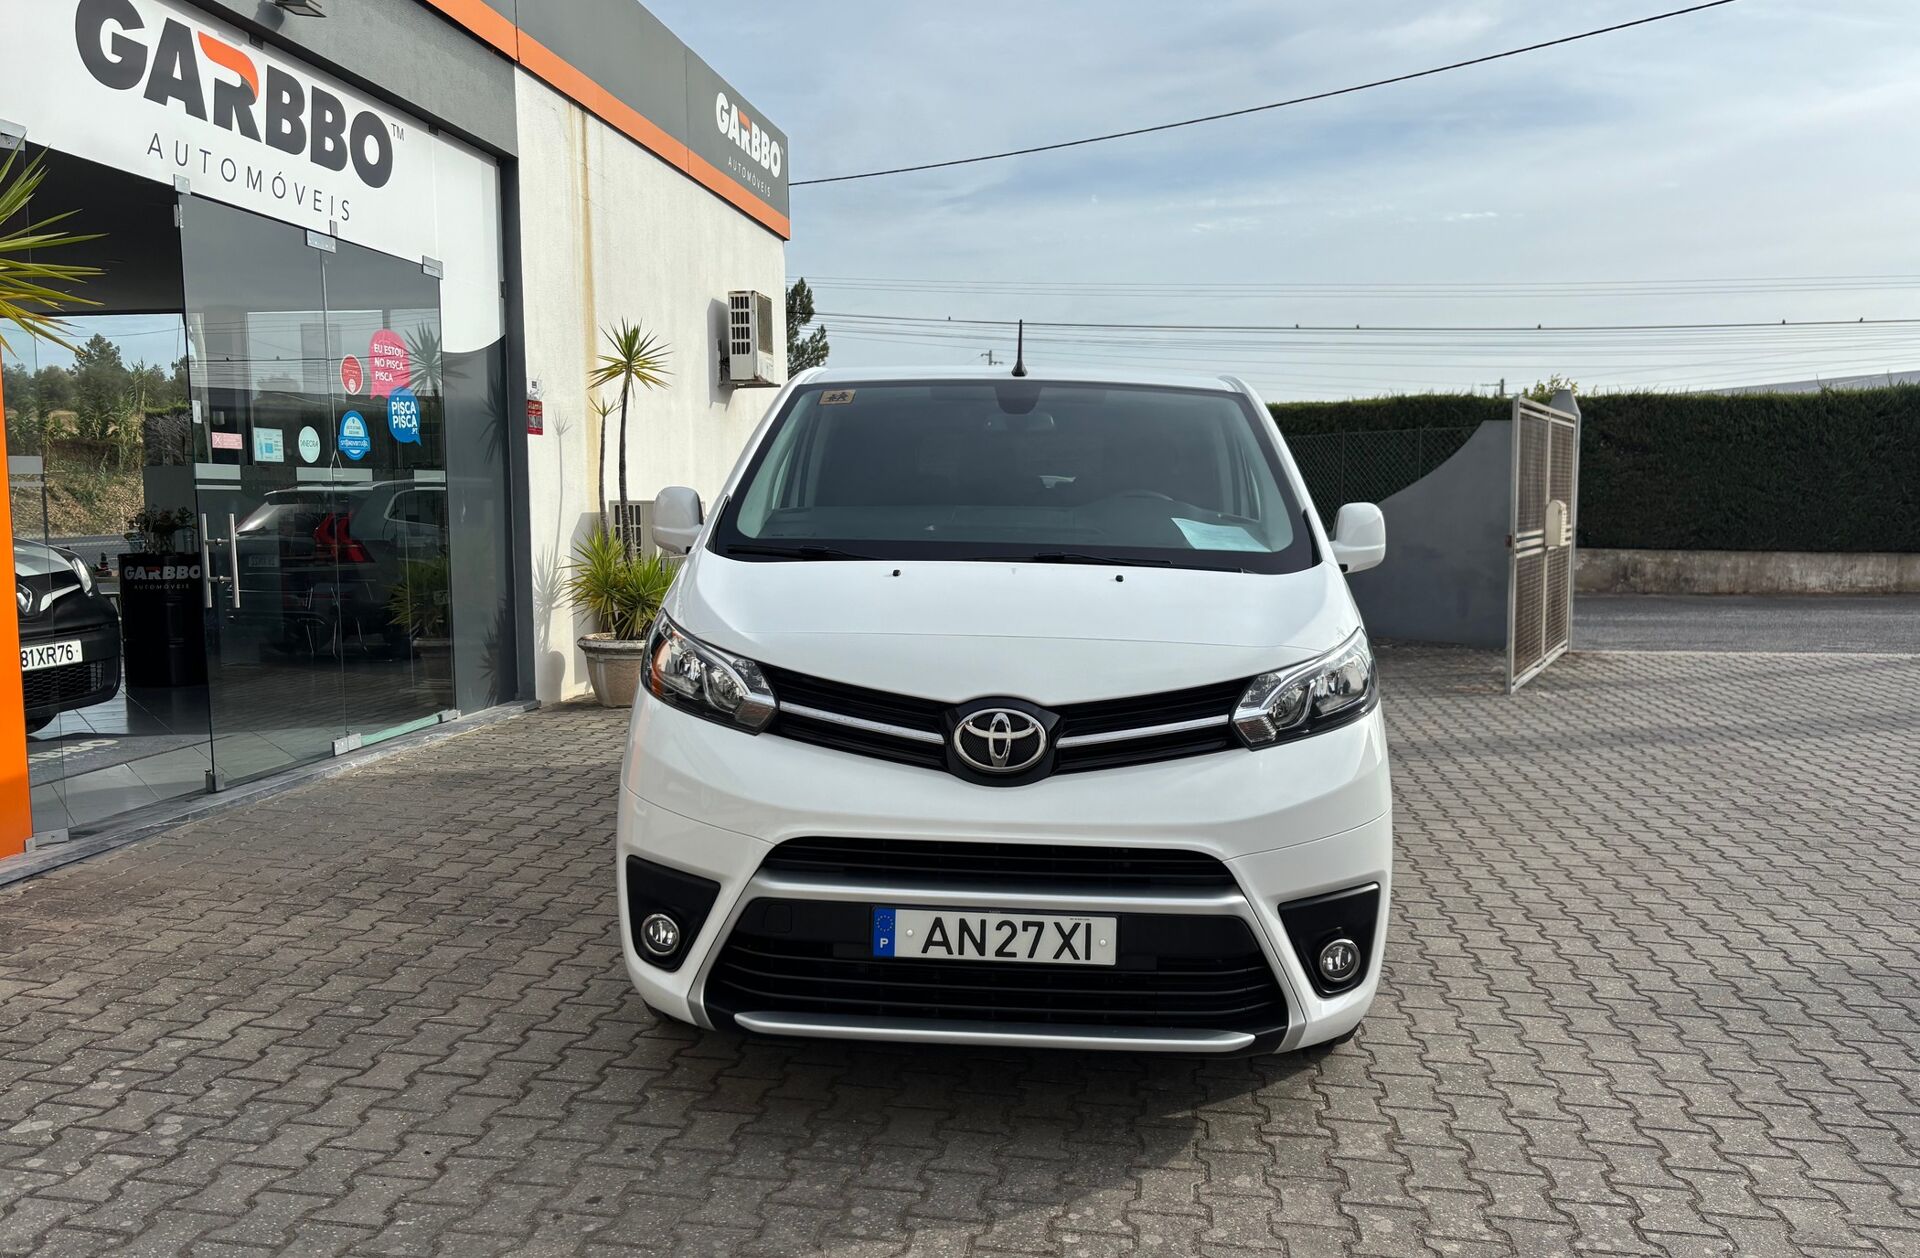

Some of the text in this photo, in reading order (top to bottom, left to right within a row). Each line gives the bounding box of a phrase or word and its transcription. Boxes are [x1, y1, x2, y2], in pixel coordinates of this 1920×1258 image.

[75, 0, 393, 189] GARBBO
[716, 92, 781, 178] GARBBO
[147, 133, 350, 221] AUTOMÓVEIS
[384, 345, 404, 357] ESTOU
[375, 357, 404, 371] NO PISCA
[375, 371, 393, 382] PISCA
[392, 415, 417, 428] PISCA
[124, 565, 201, 580] GARBBO
[21, 644, 74, 668] 81XR76
[880, 938, 889, 949] P
